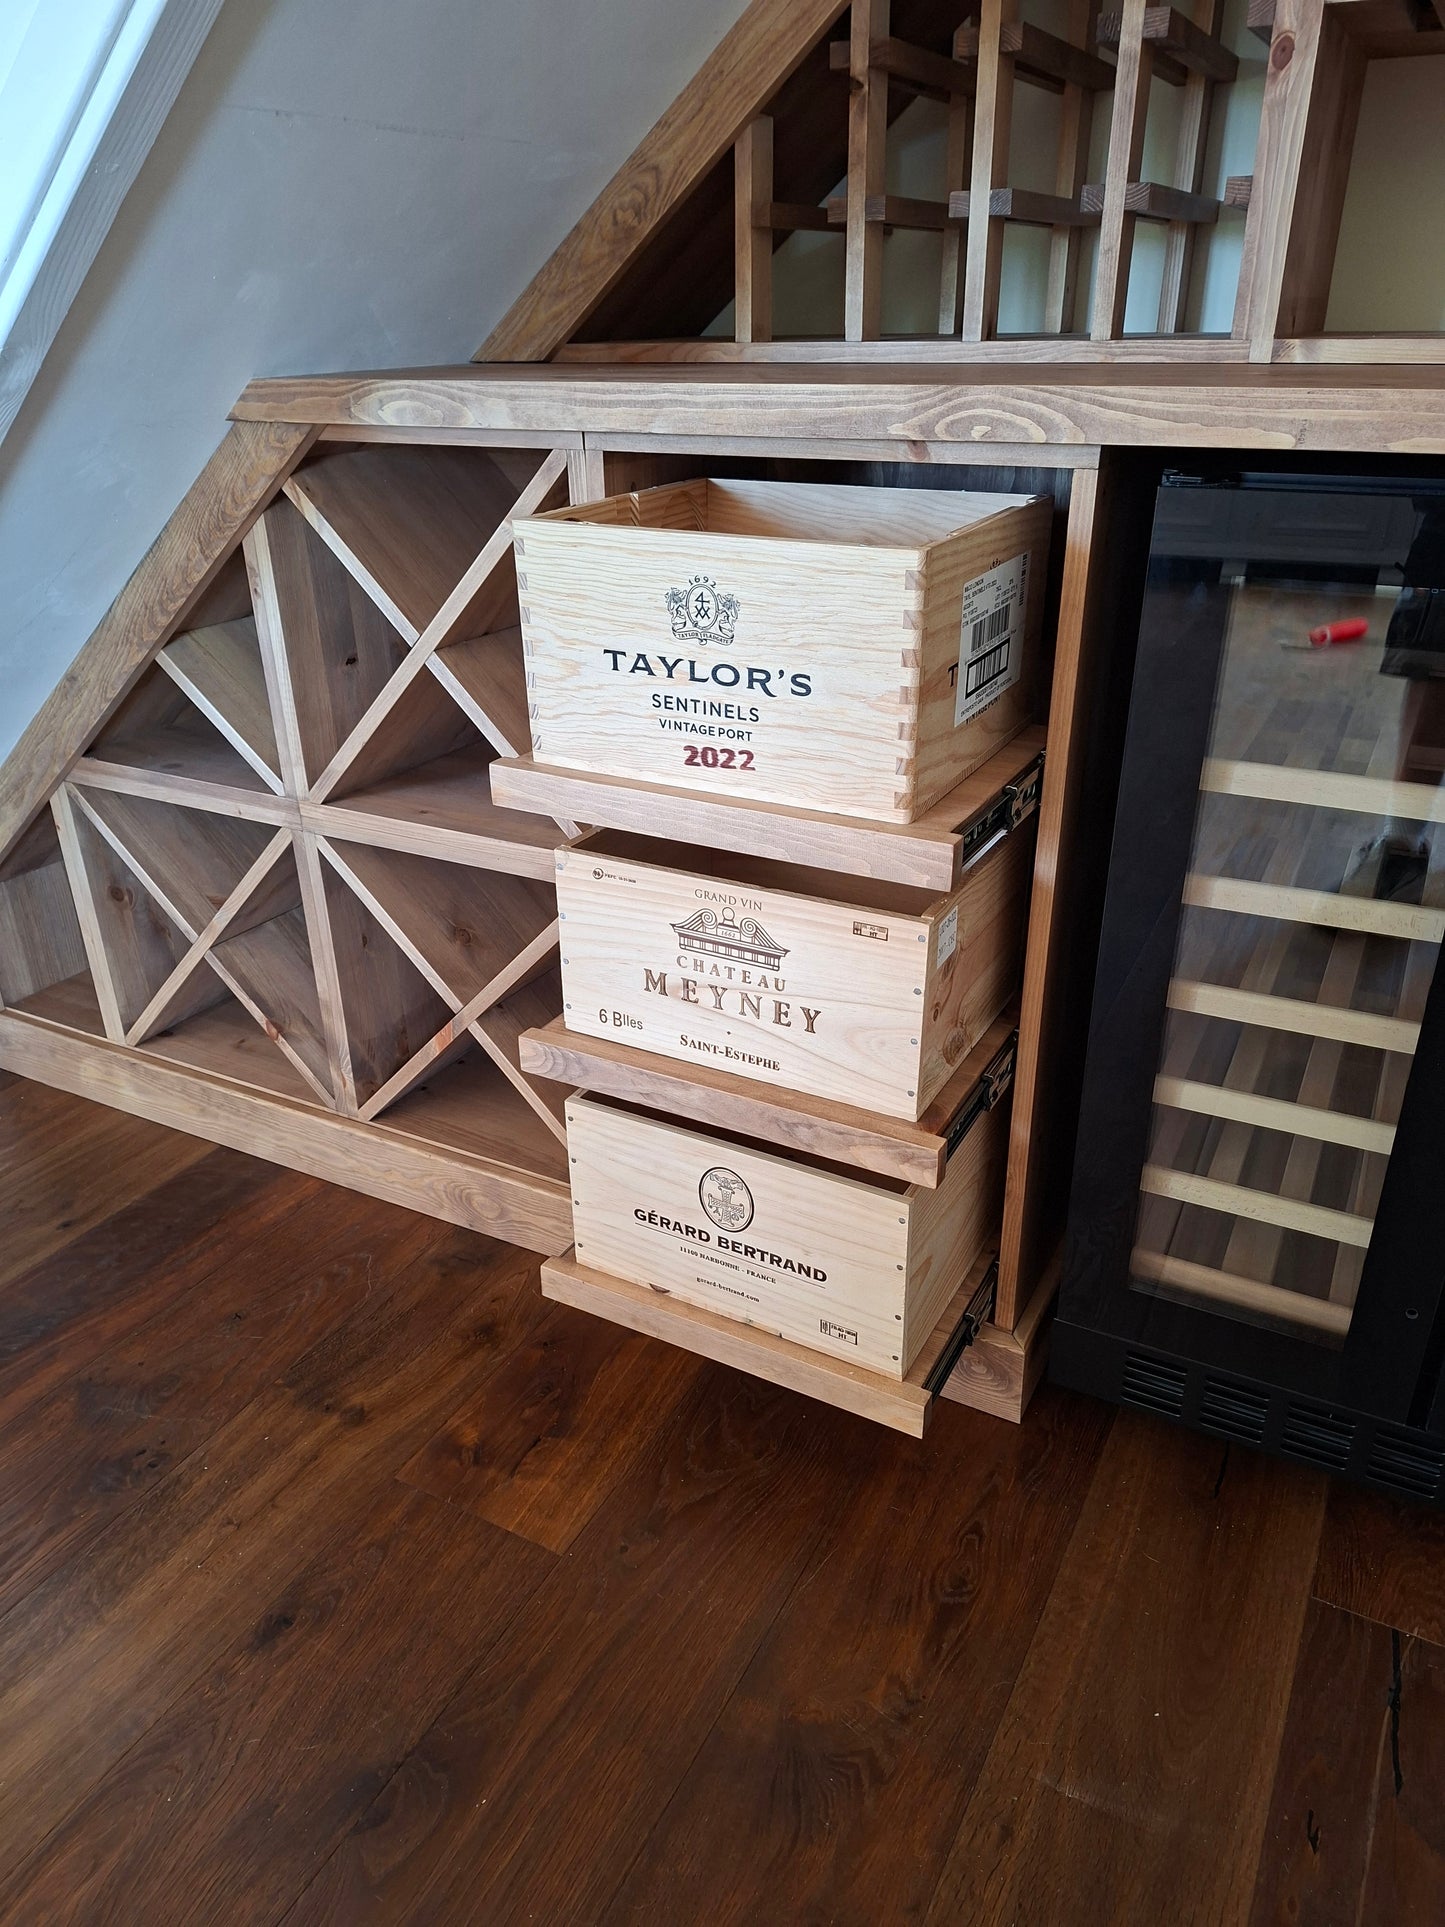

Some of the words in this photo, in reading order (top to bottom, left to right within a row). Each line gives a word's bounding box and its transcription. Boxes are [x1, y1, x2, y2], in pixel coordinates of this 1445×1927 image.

[688, 574, 717, 589] 1692
[603, 648, 812, 698] TAYLOR'S
[651, 693, 760, 723] SENTINELS
[658, 718, 715, 737] VINTAGE
[717, 727, 753, 742] PORT
[682, 745, 757, 771] 2022
[694, 888, 737, 906] GRAND
[740, 898, 763, 912] VIN
[721, 930, 736, 939] 1662
[676, 955, 786, 992] CHATEAU
[643, 968, 822, 1034] MEYNEY
[599, 1008, 608, 1024] 6
[679, 1034, 781, 1072] SAINT-ESTEPHE
[633, 1208, 712, 1244] GÉRARD
[717, 1235, 828, 1283] BERTRAND
[679, 1246, 699, 1258] 11100
[699, 1253, 741, 1273] NARBONNE
[746, 1268, 777, 1285] FRANCE
[696, 1276, 761, 1303] gerard-bertrand.com
